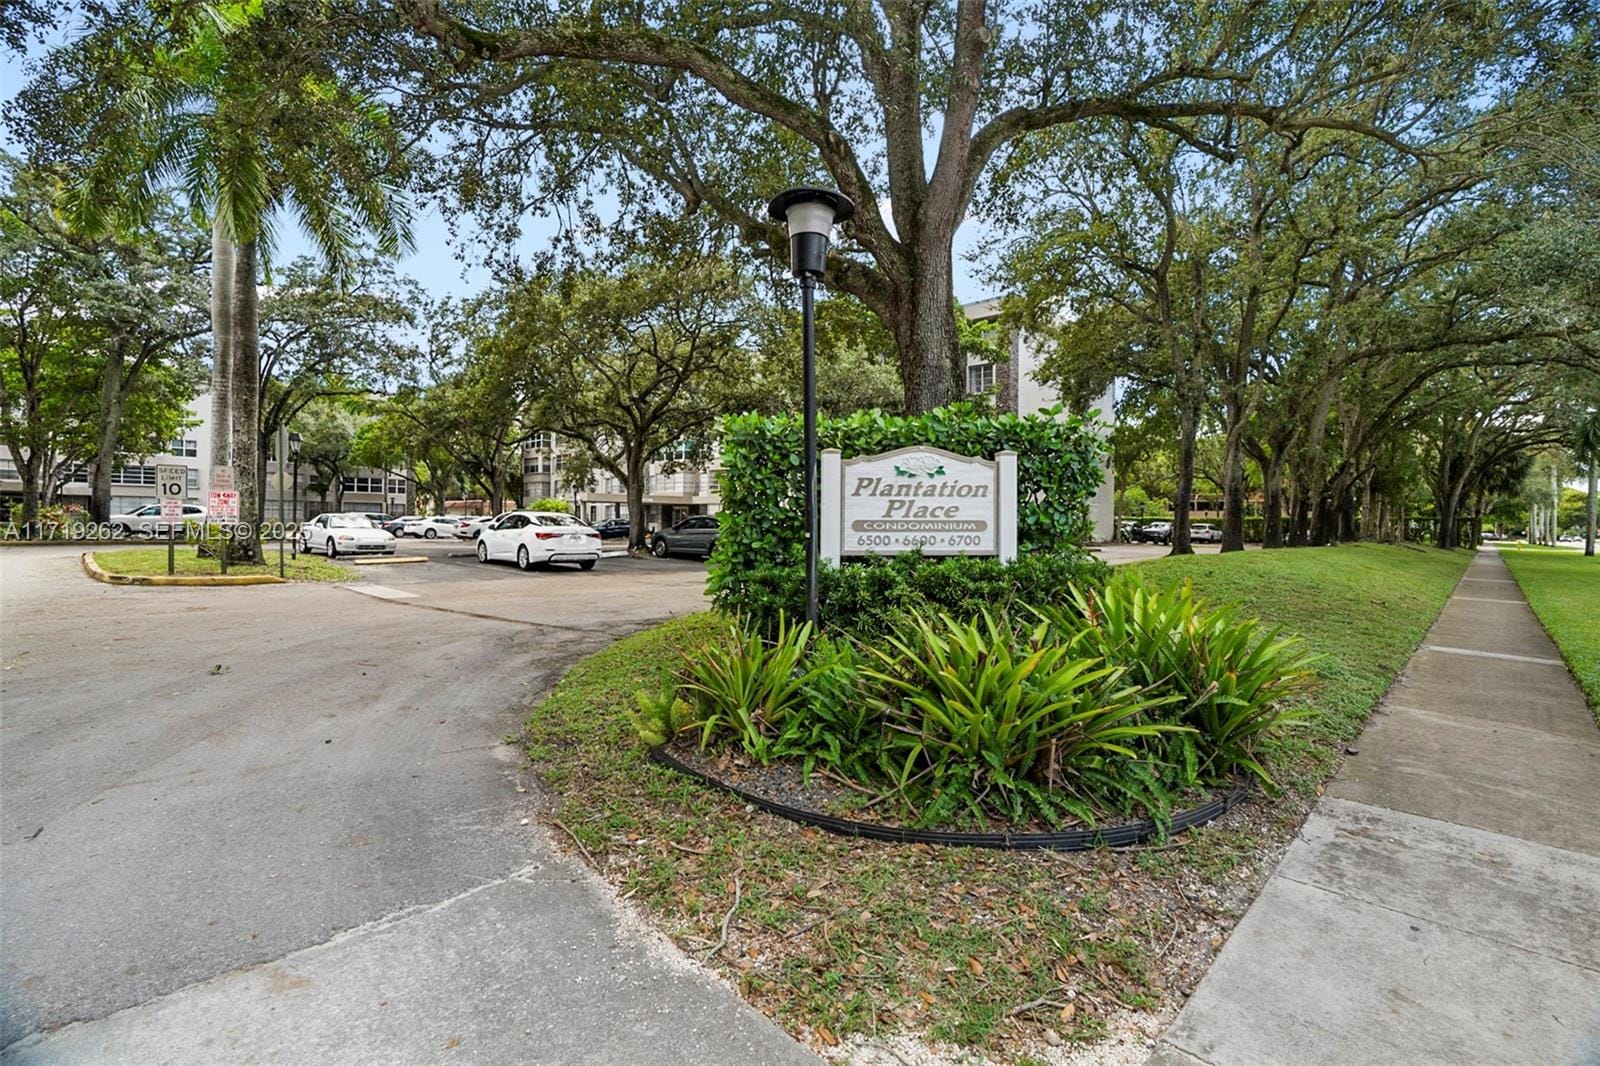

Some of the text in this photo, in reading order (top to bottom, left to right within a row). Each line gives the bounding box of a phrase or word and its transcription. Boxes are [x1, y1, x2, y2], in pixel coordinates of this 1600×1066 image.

[161, 482, 182, 495] 10
[850, 477, 989, 498] Plantation
[881, 499, 960, 519] Place
[863, 521, 977, 531] CONDOMINIUM
[857, 535, 891, 547] 6500
[948, 535, 982, 547] 6700
